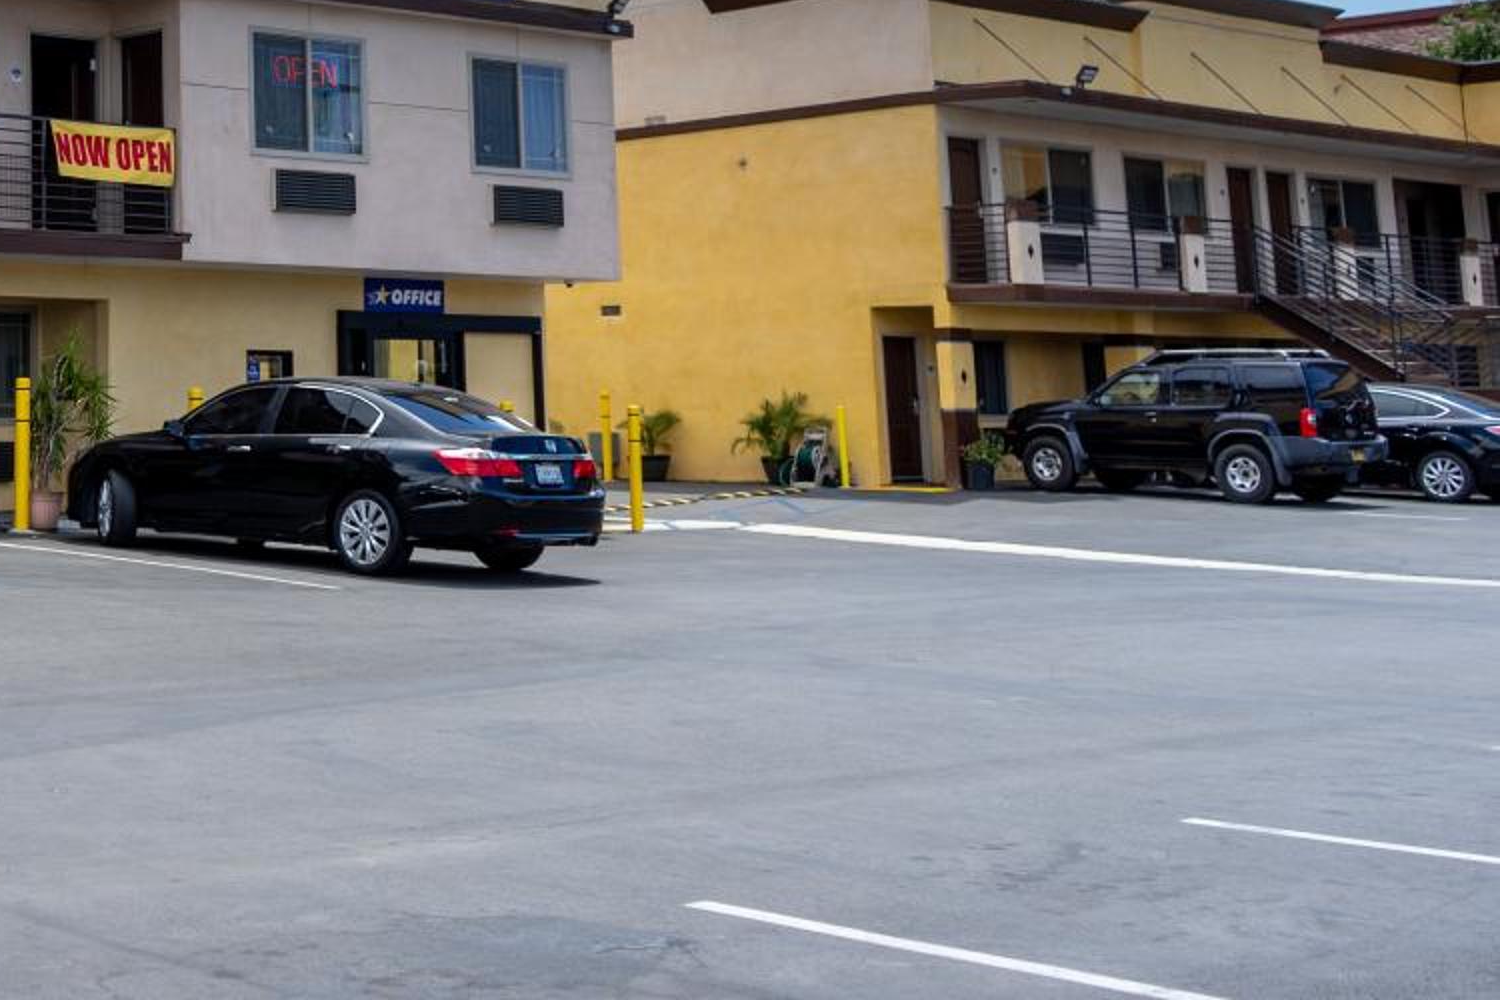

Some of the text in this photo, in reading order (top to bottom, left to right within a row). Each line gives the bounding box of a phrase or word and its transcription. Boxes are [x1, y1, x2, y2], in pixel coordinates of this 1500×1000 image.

[272, 55, 338, 88] OPEN
[55, 132, 173, 174] NOW OPEN
[391, 288, 442, 306] OFFICE
